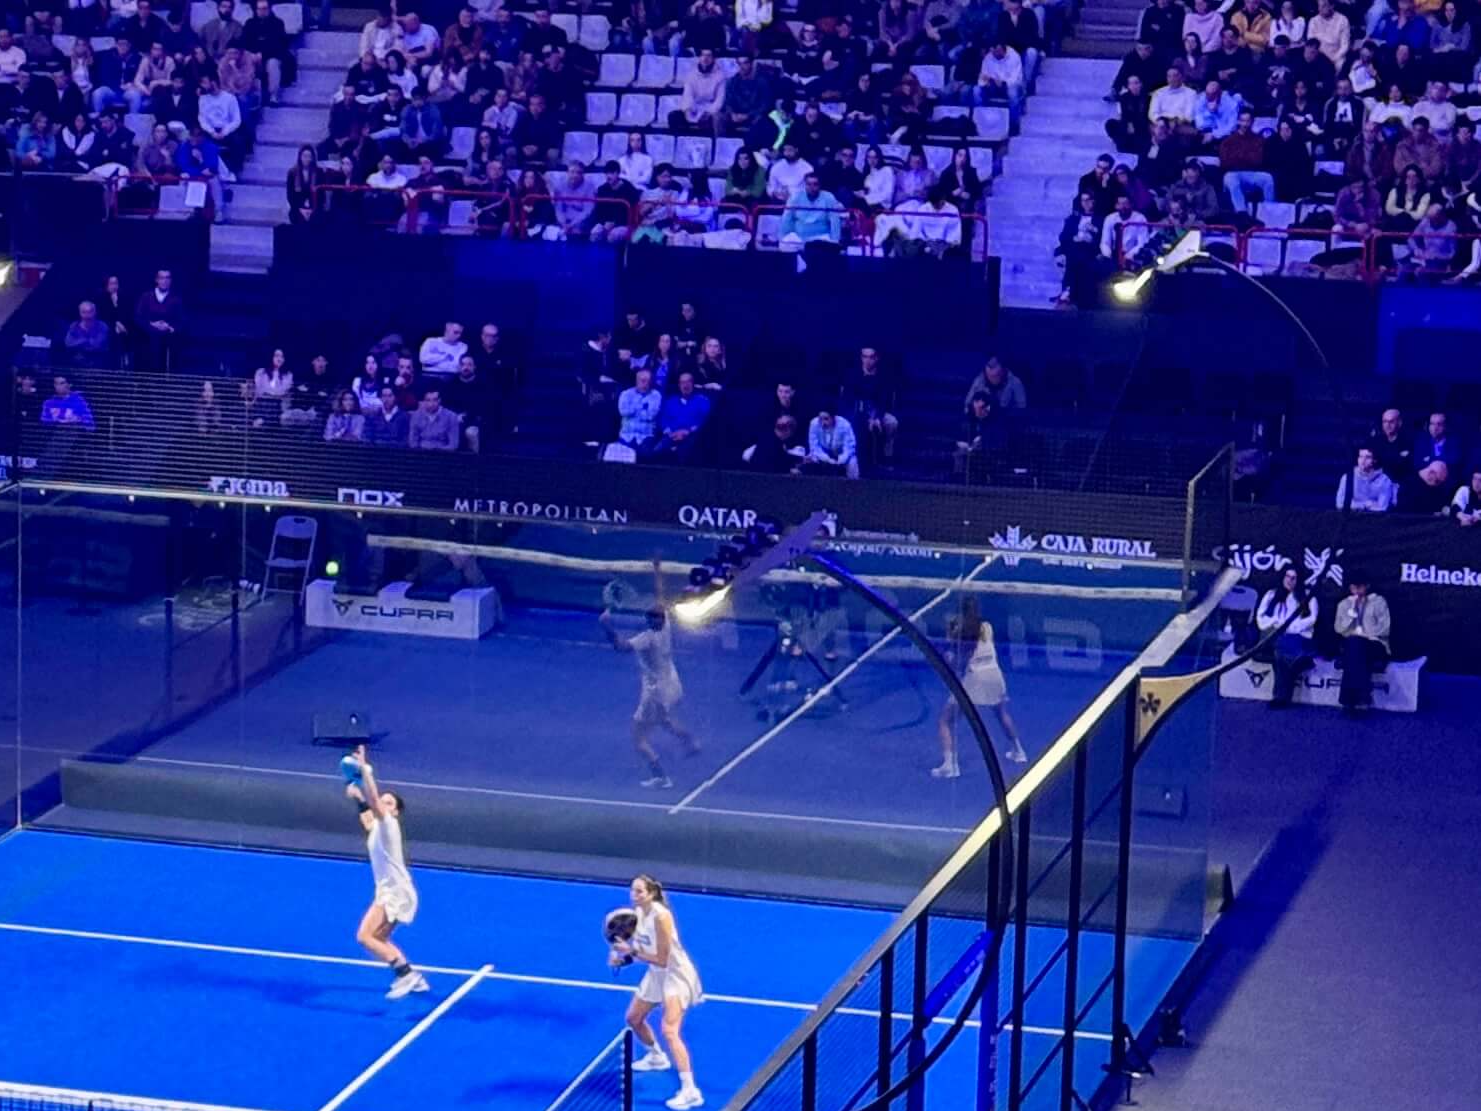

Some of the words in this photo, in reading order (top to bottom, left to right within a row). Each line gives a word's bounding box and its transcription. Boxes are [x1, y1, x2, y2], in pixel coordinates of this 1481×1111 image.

[677, 504, 758, 530] QATAR
[1040, 533, 1088, 554] CAJA
[1090, 536, 1157, 558] RURAL
[360, 604, 455, 622] CUPRA
